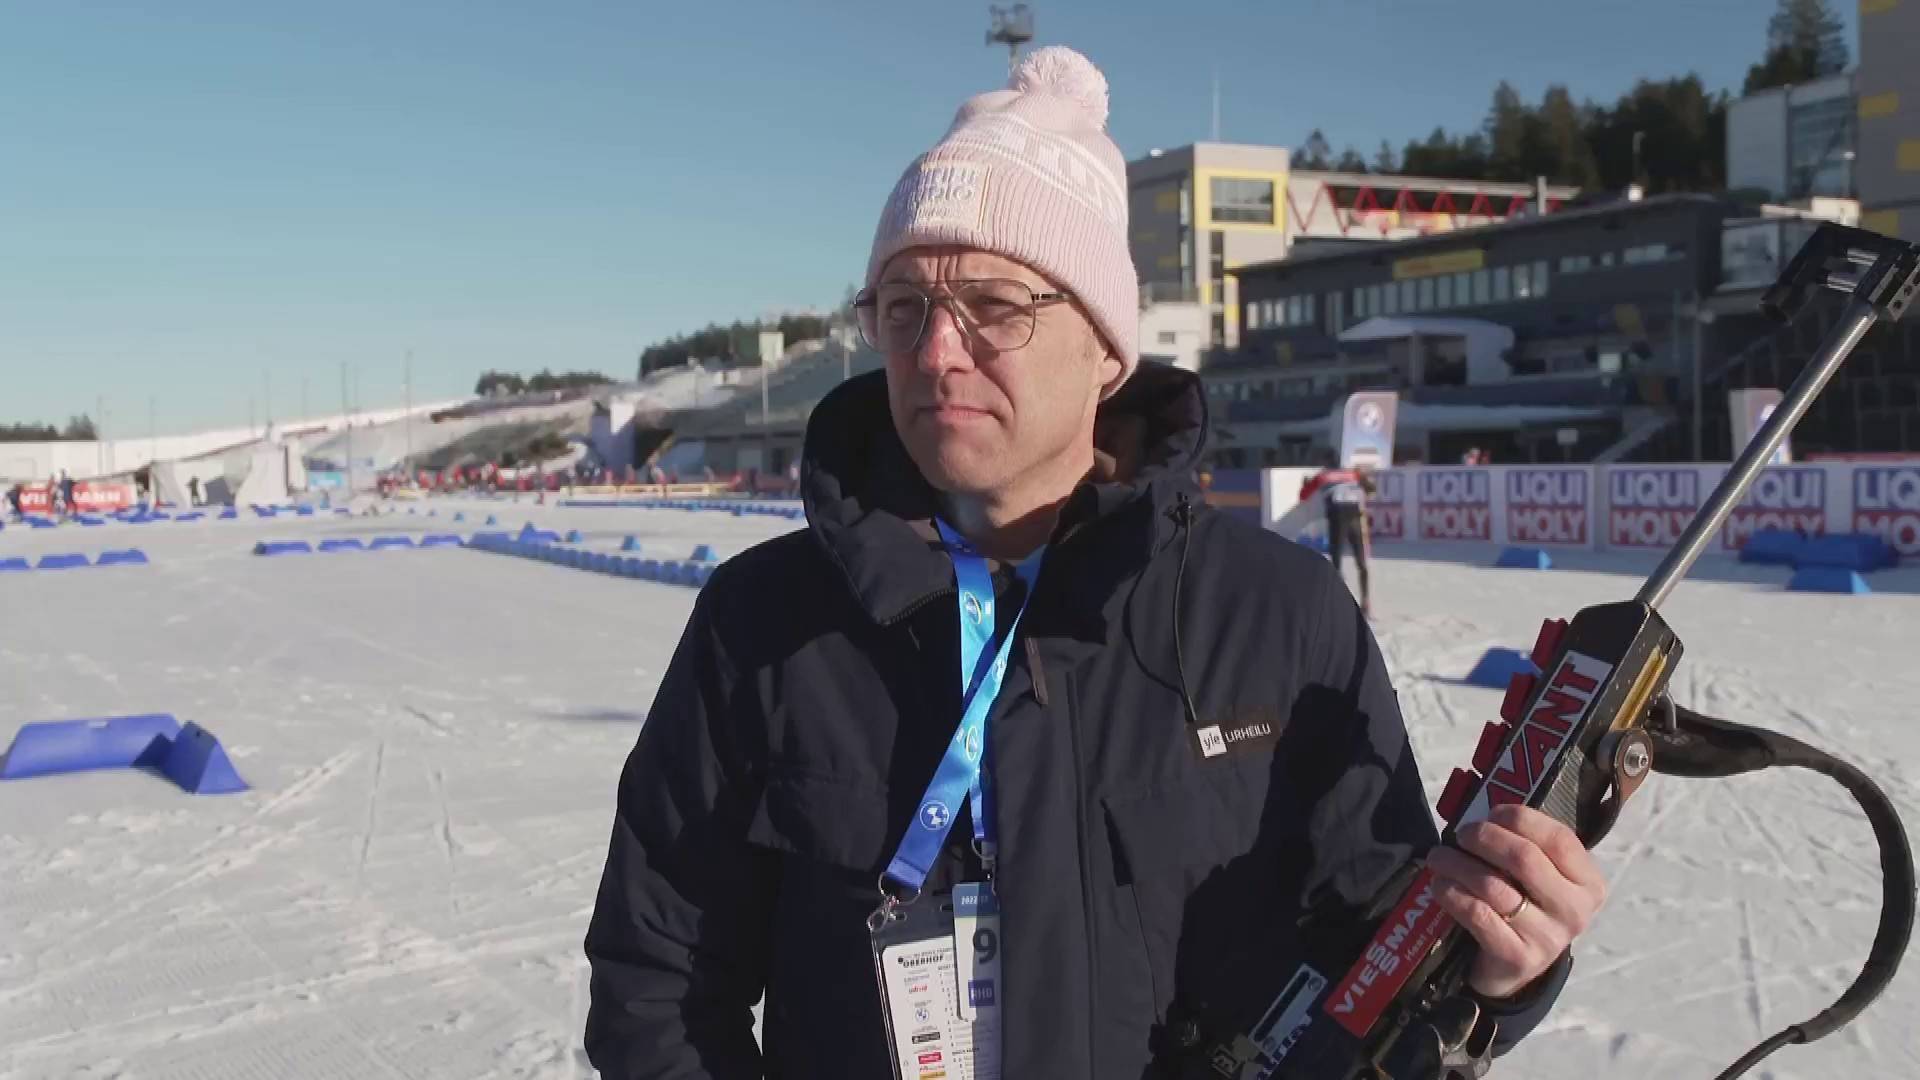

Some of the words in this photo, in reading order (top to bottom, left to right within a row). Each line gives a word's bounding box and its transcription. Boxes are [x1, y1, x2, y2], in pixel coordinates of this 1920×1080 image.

[1421, 470, 1489, 502] LIQUI
[1509, 470, 1584, 504] LIQUI
[1611, 471, 1696, 506] LIQUI
[1421, 507, 1489, 537] MOLY
[1510, 508, 1585, 541] MOLY
[1225, 723, 1271, 742] URHEILU
[973, 927, 997, 964] 9
